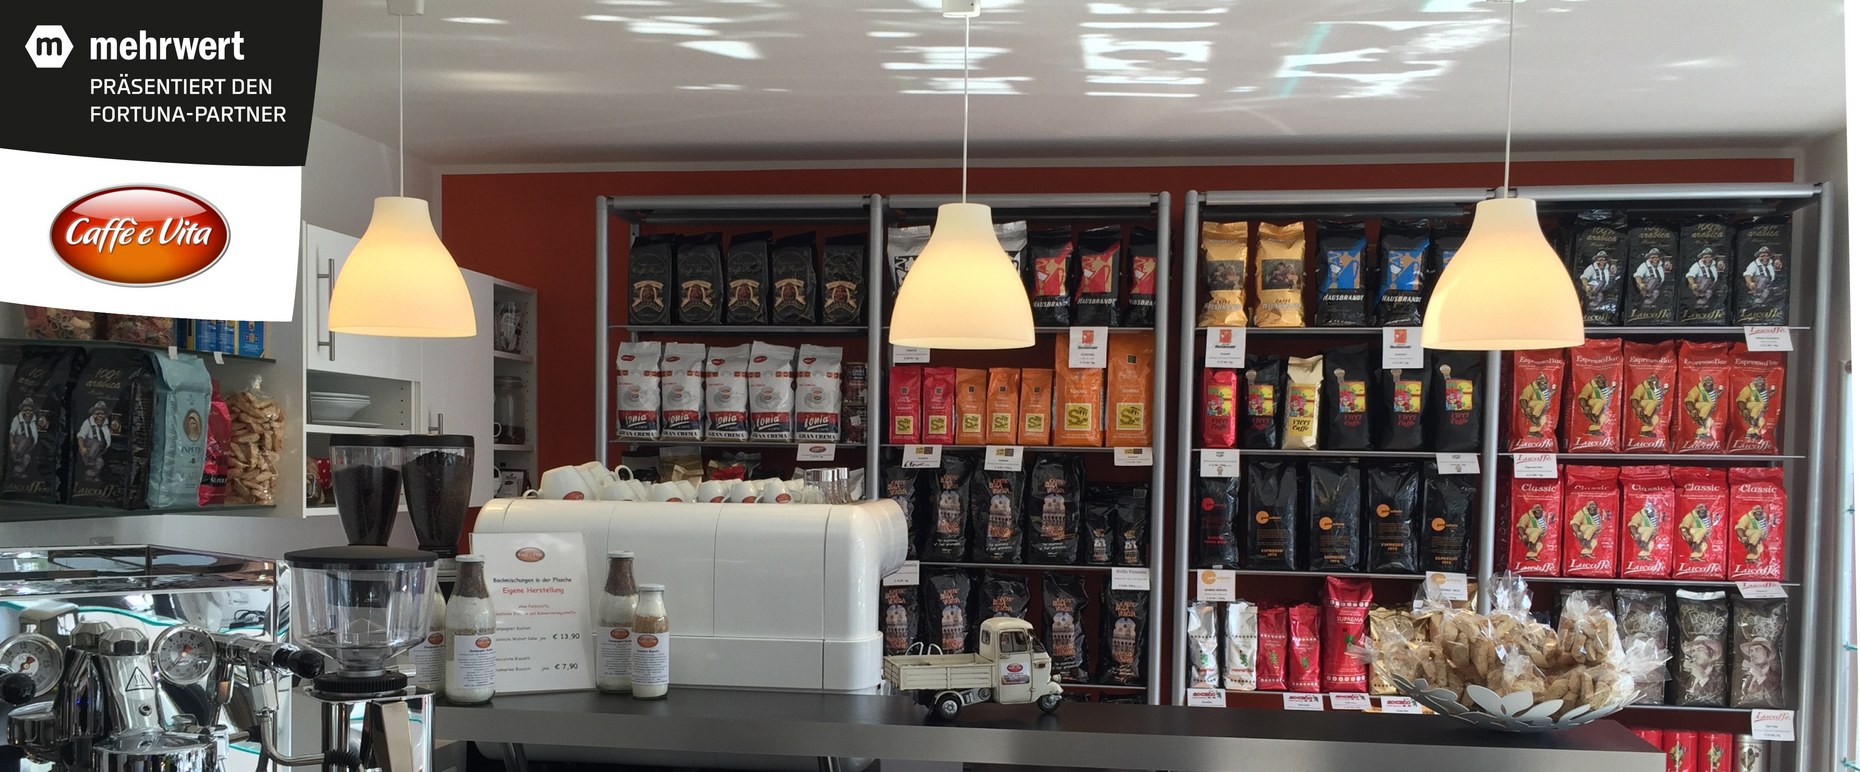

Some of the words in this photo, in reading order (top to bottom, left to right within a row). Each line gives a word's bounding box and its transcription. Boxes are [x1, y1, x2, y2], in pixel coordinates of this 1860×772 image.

[1521, 483, 1557, 492] Classic
[1631, 483, 1666, 491] Classic
[1684, 483, 1721, 492] Classic
[1740, 484, 1778, 493] Classic
[502, 587, 524, 595] Eigene
[527, 587, 564, 595] Herstellung
